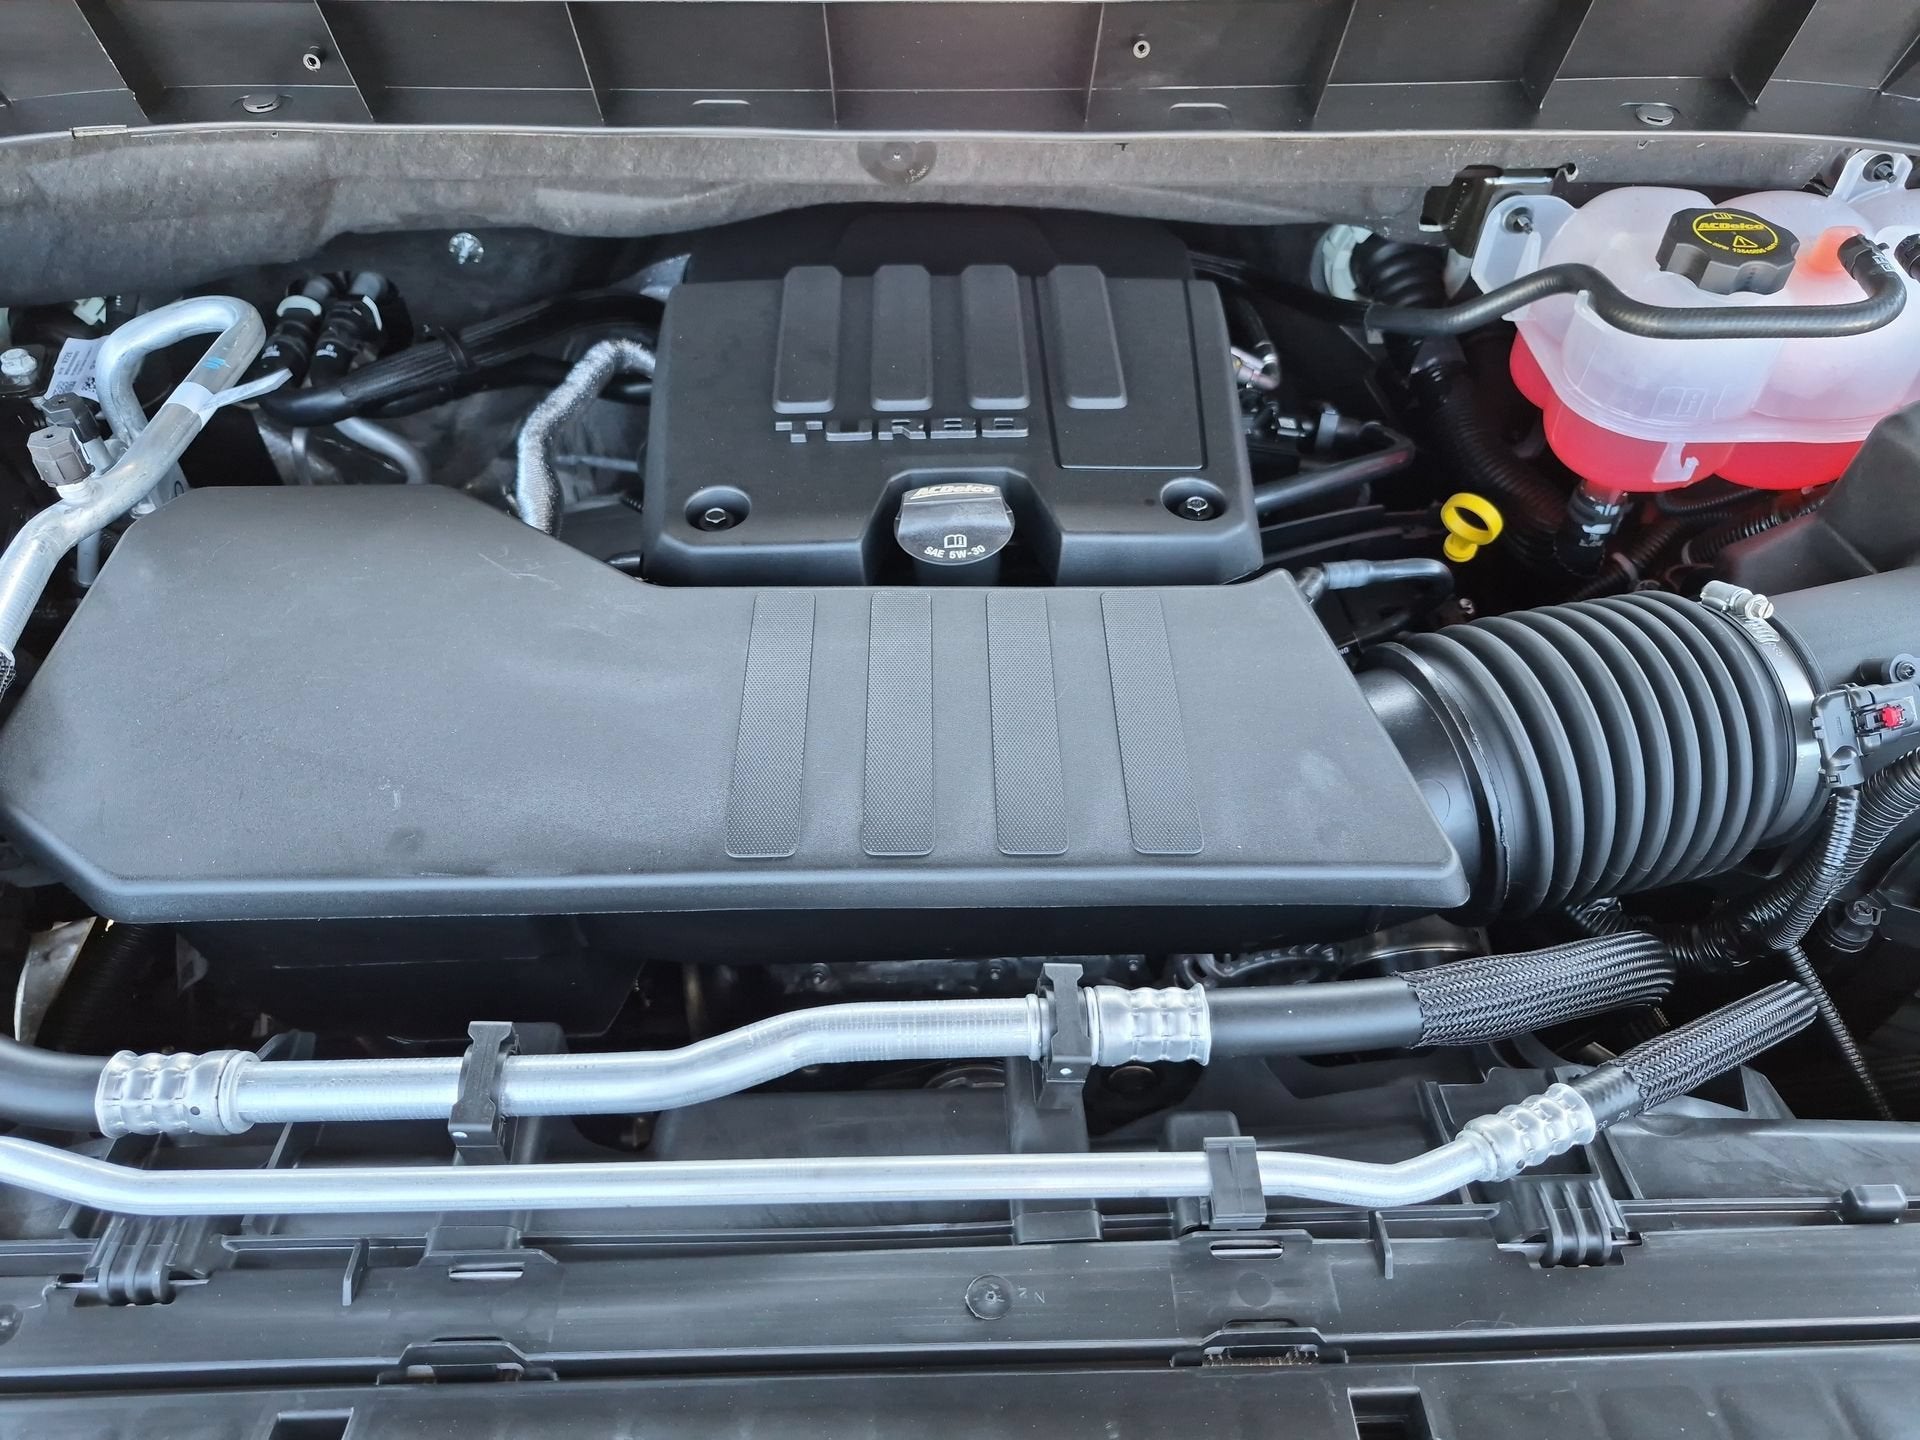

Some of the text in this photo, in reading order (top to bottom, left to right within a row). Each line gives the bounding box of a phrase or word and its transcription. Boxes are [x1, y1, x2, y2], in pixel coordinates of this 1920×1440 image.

[1697, 222, 1765, 231] ACDelco
[911, 485, 996, 499] ACDelco
[924, 544, 986, 559] SAE 5W-30
